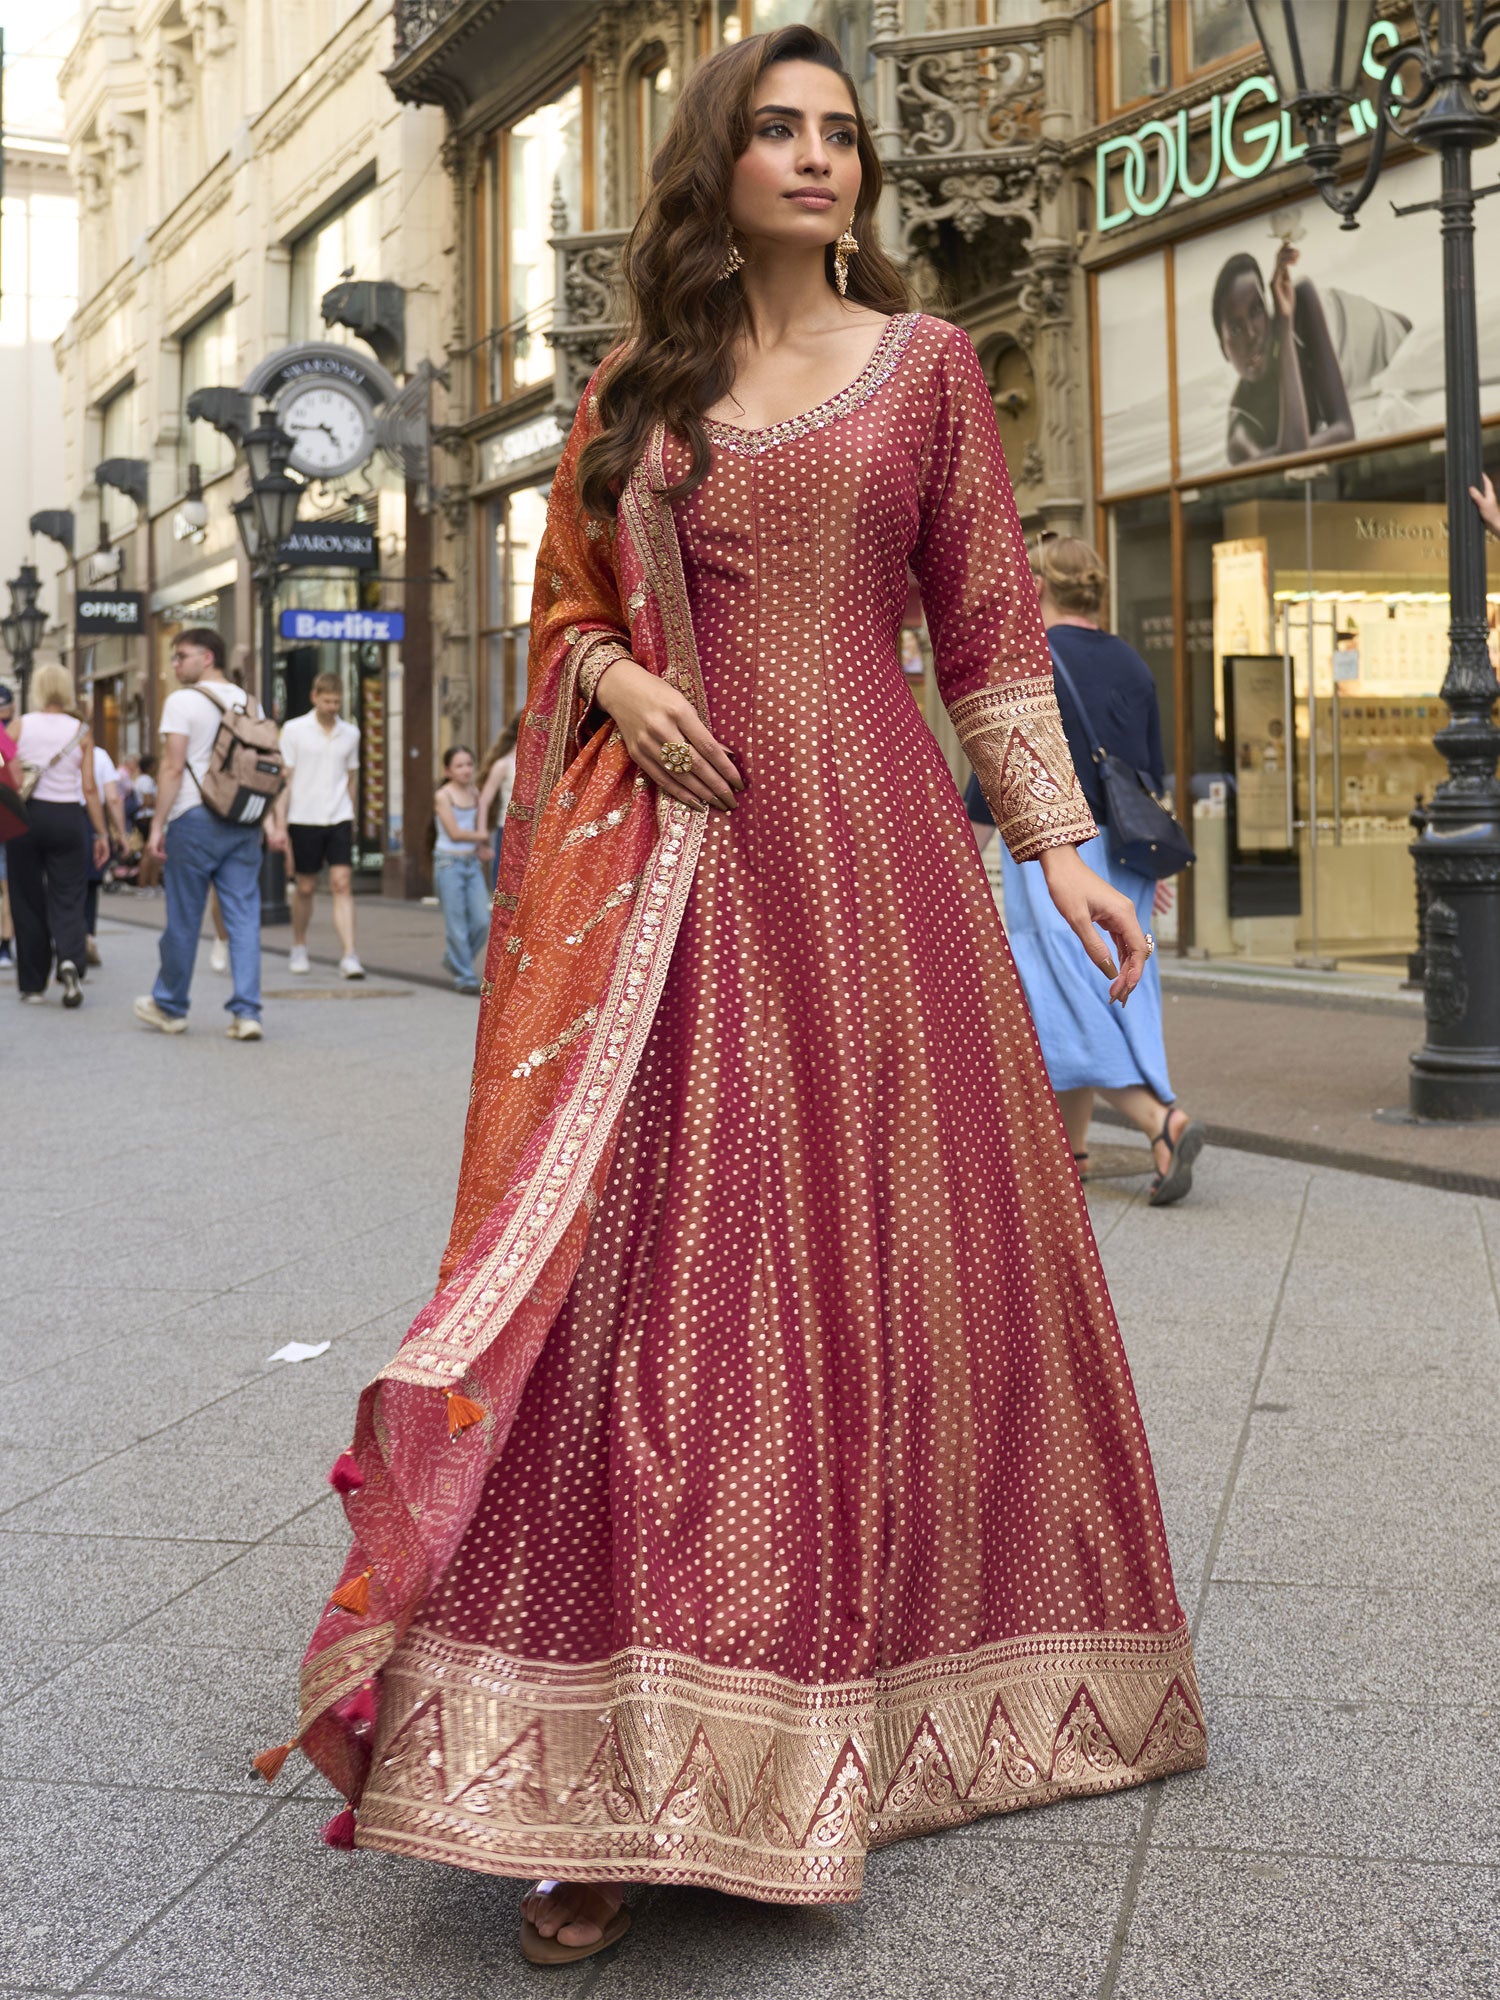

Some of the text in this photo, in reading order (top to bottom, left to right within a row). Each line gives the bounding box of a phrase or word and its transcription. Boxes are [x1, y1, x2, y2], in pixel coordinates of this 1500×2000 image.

[1097, 20, 1403, 231] DOUGLS
[1355, 517, 1434, 540] Maison
[80, 602, 138, 617] OFFICE
[295, 613, 391, 639] Berlitz
